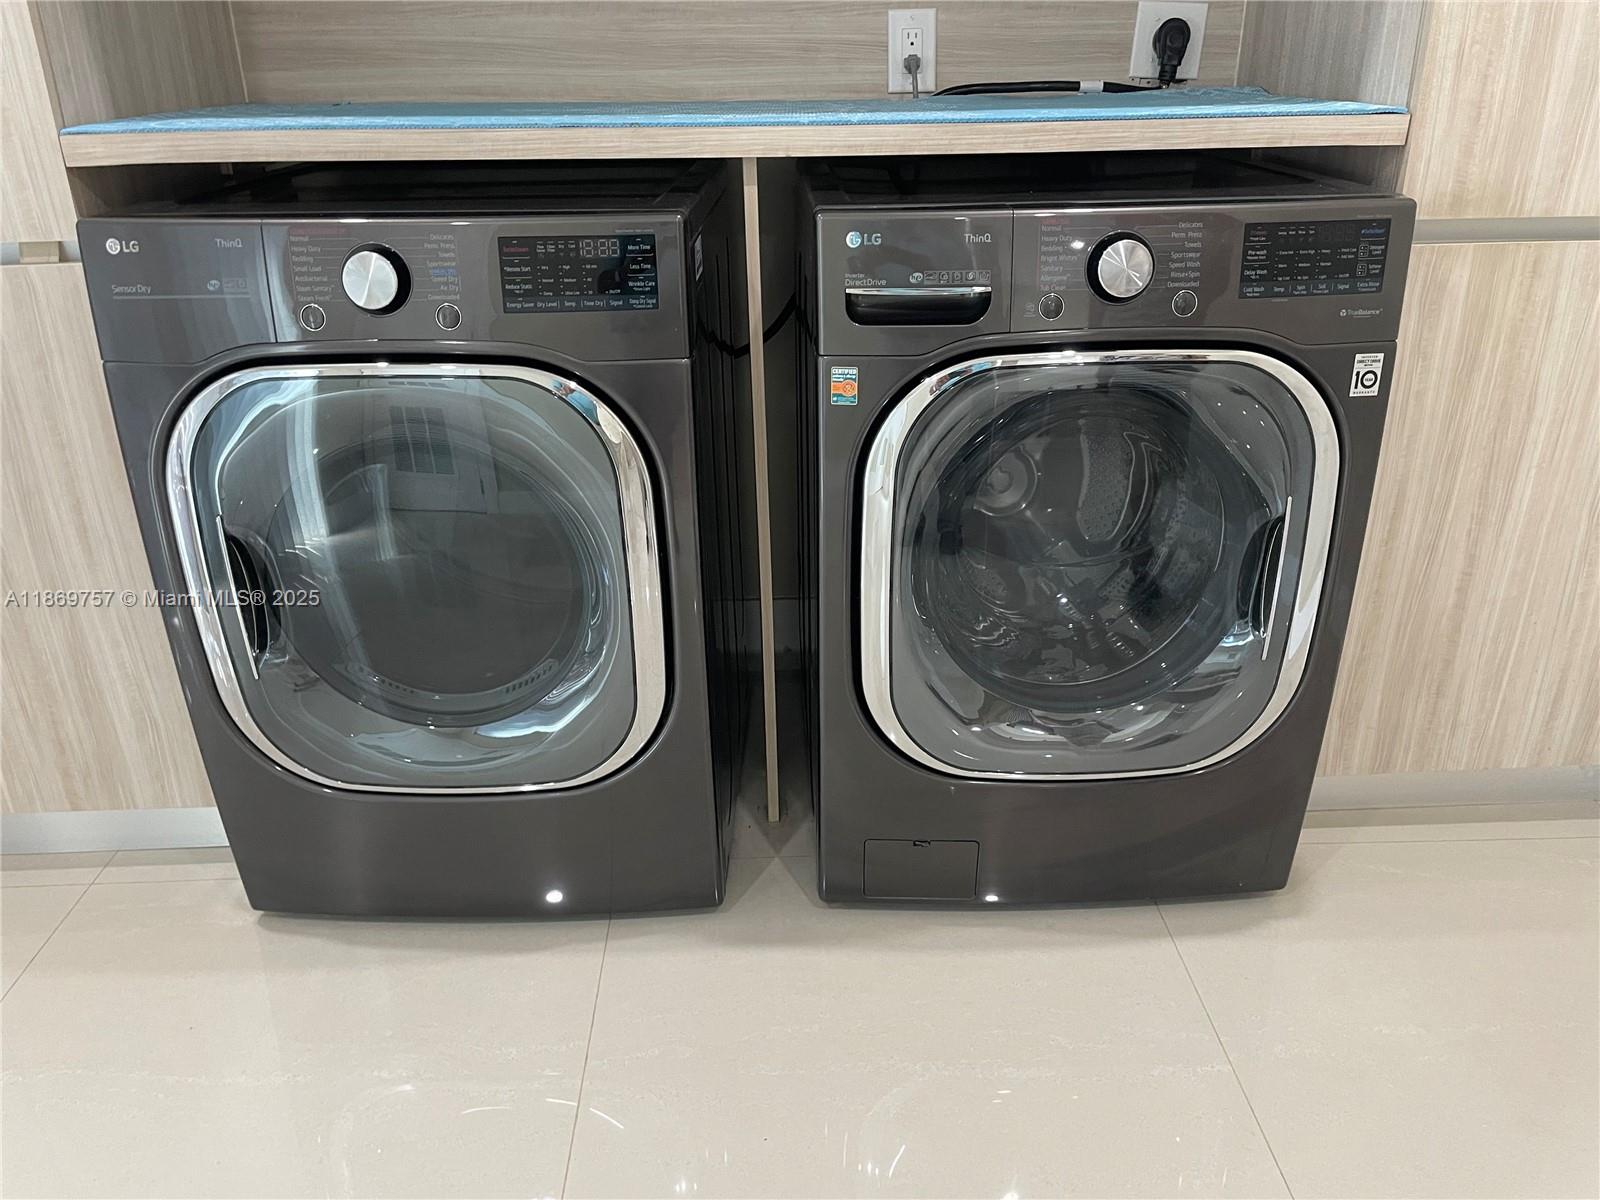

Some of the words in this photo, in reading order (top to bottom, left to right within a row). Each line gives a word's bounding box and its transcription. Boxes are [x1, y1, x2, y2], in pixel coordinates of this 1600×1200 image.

[215, 238, 243, 248] ThinQ
[864, 233, 882, 245] LG
[964, 233, 992, 243] ThinQ
[122, 240, 139, 253] LG
[1354, 370, 1378, 389] 10
